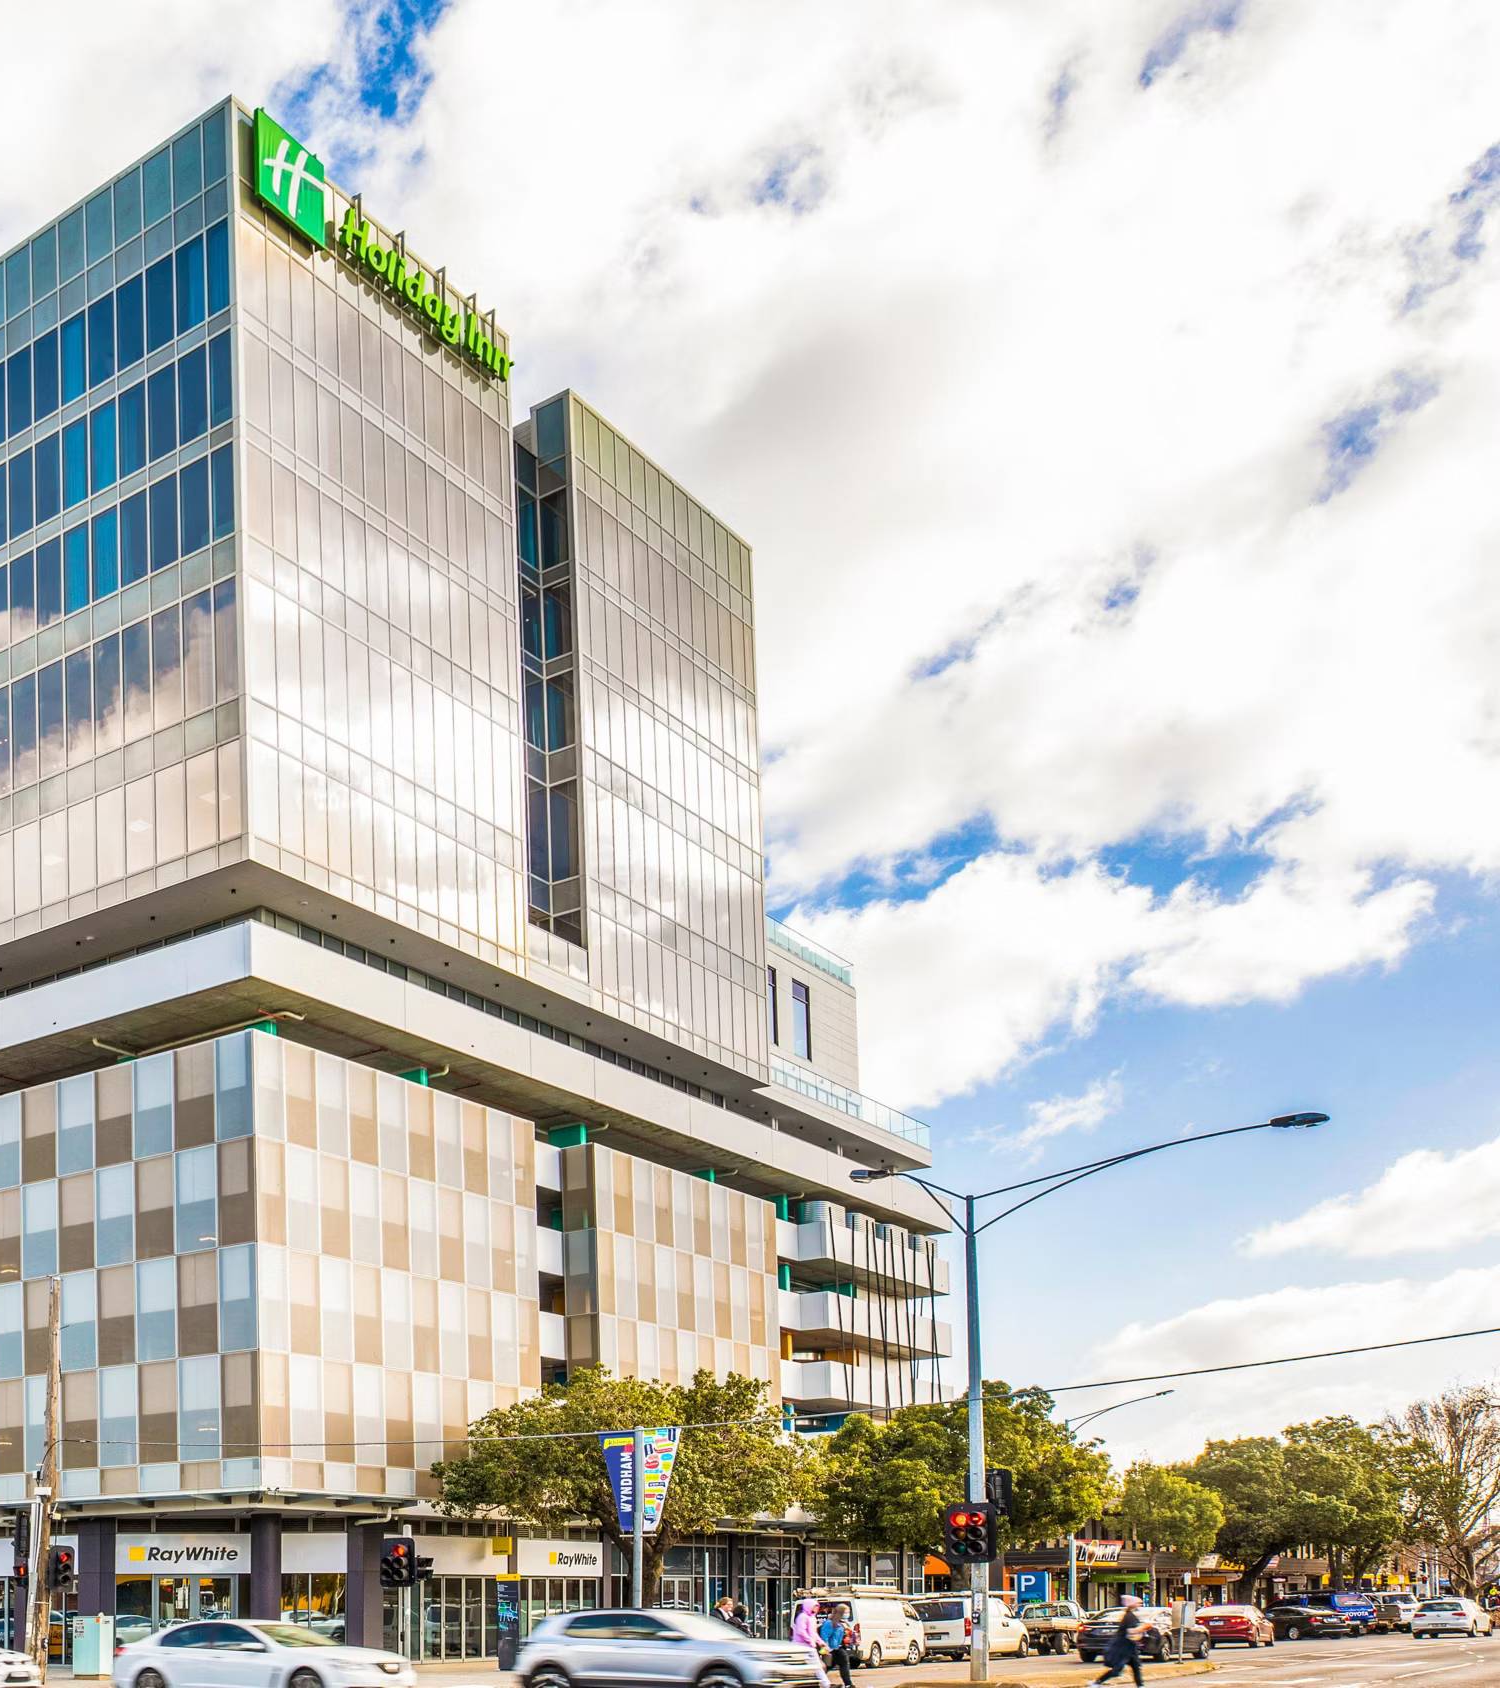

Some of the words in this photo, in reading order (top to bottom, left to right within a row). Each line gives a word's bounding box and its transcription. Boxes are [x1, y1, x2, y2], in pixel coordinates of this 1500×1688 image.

[338, 206, 462, 345] Holiday
[464, 312, 512, 383] Inn
[620, 1452, 633, 1513] WYNDHAM
[147, 1546, 238, 1564] RayWhite
[557, 1552, 598, 1567] RayWhite
[1020, 1574, 1036, 1592] P
